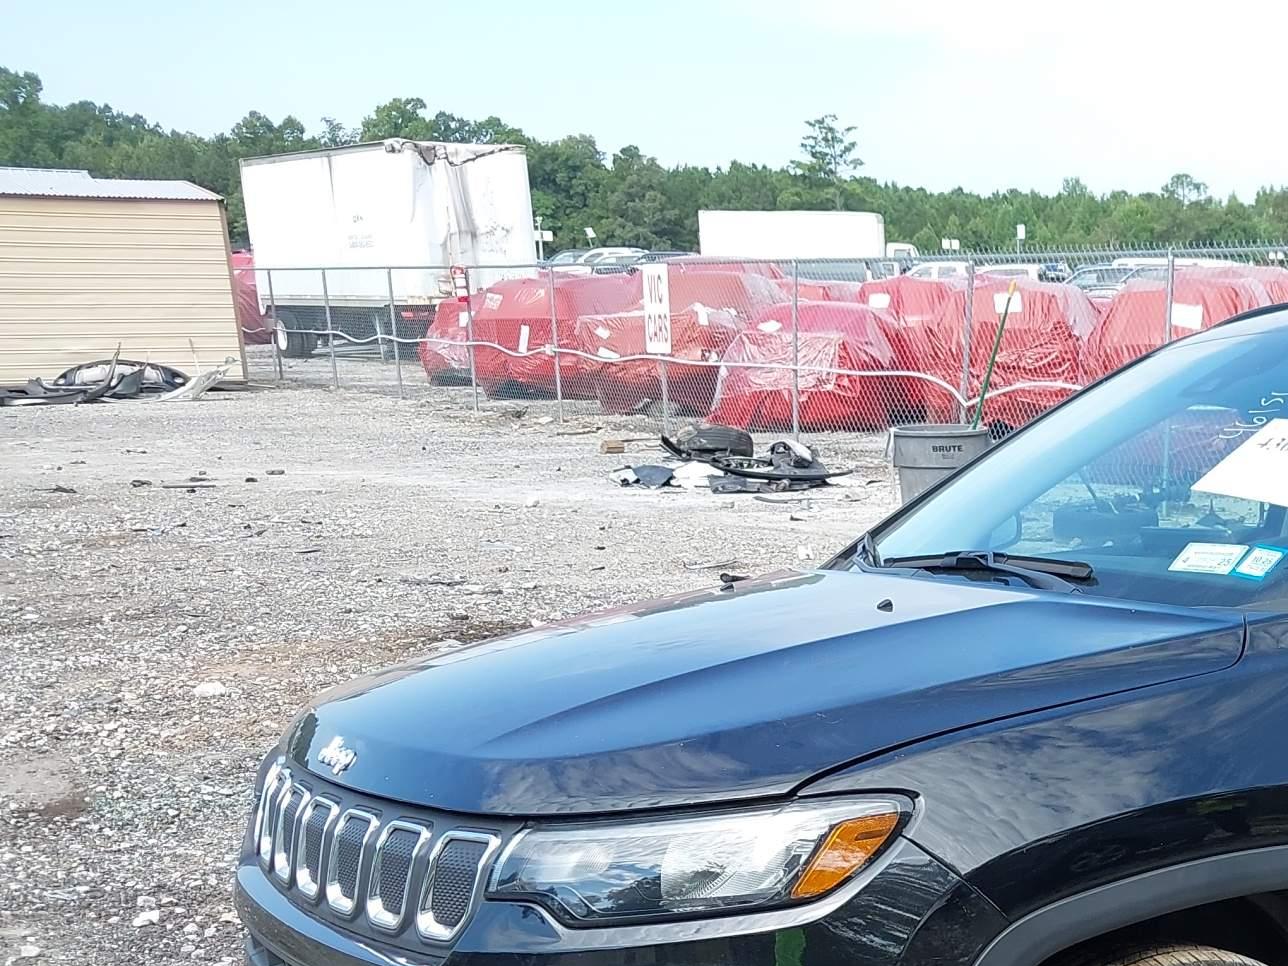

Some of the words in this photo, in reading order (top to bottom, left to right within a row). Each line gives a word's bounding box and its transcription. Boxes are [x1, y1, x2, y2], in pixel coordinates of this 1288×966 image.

[647, 273, 663, 304] VIC
[648, 313, 669, 343] CARS
[932, 445, 964, 453] BRUTE
